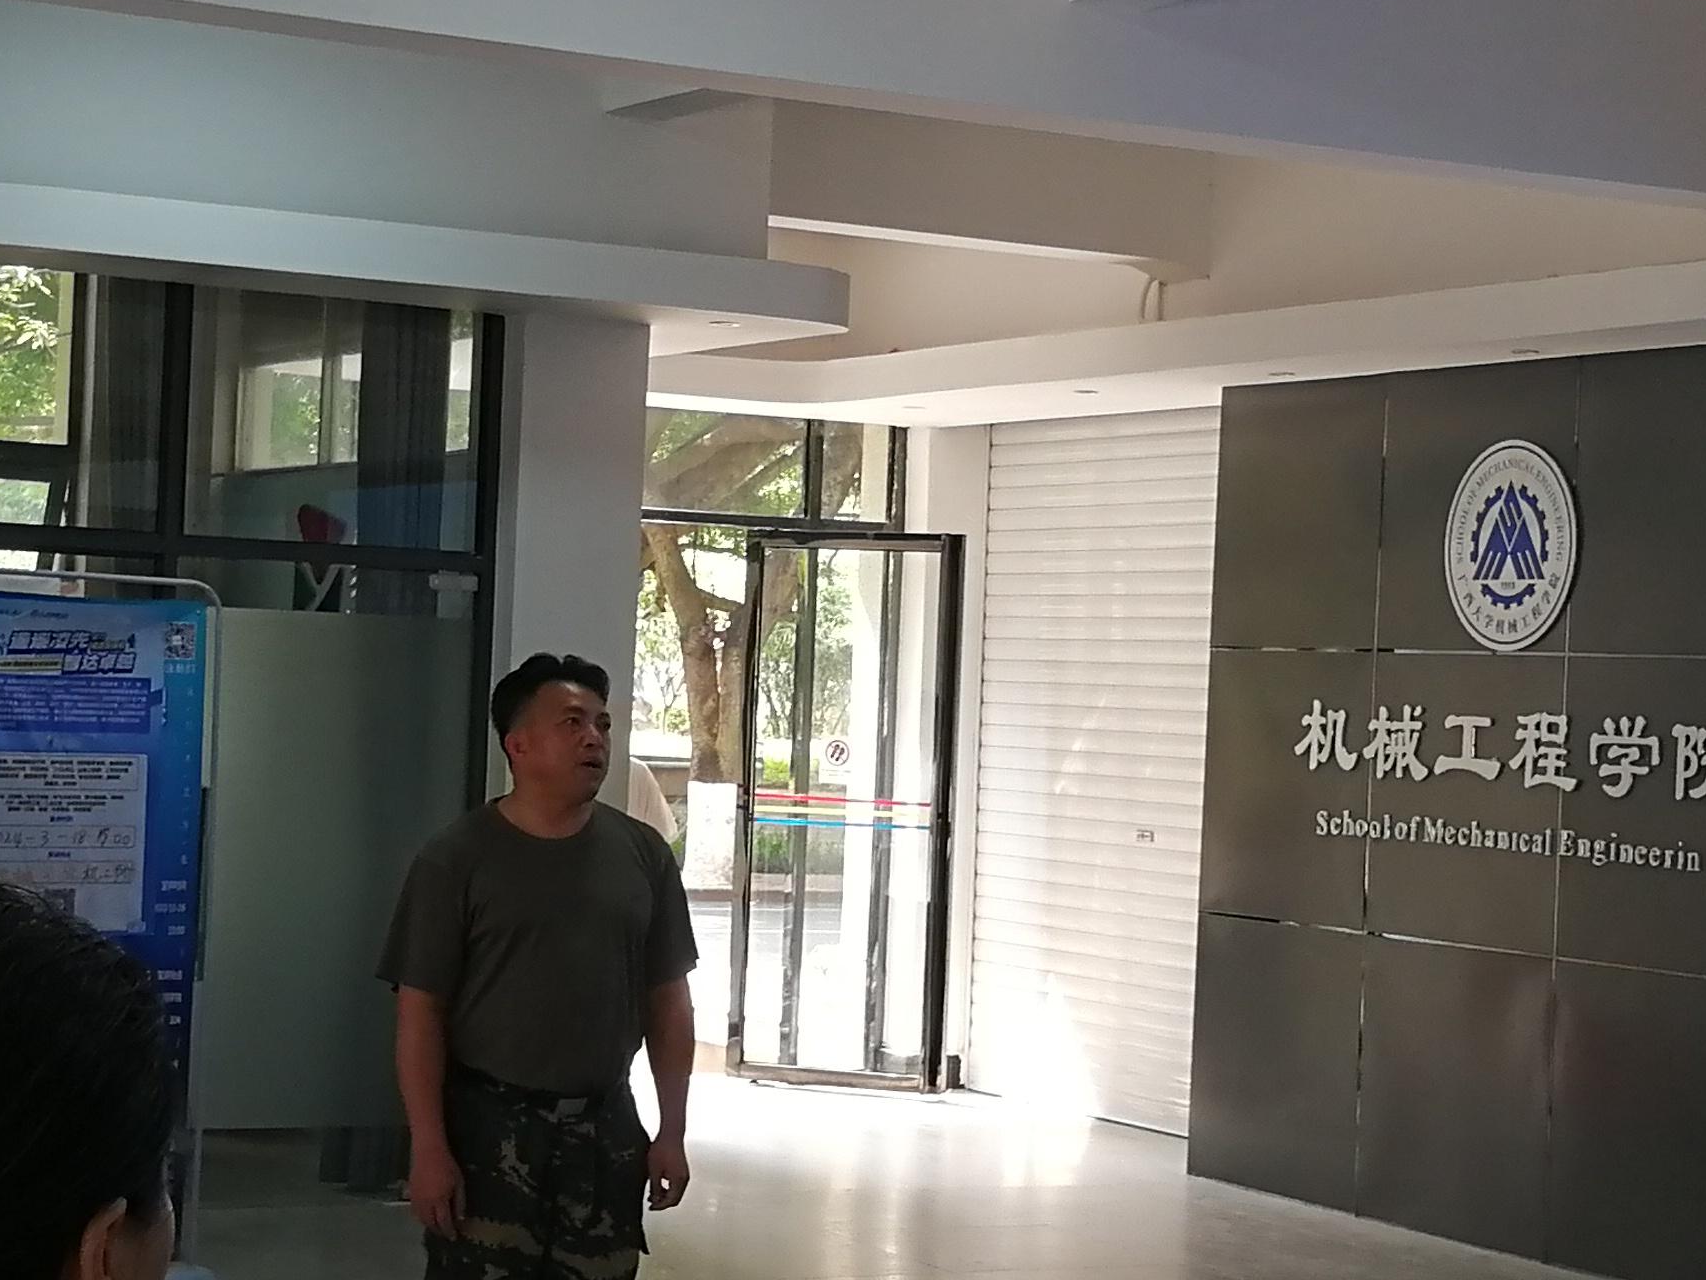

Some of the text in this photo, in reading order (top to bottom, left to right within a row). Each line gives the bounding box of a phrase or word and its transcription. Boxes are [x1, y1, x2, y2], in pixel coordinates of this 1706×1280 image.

[1315, 809, 1702, 873] School of Mechanical Engineerin
